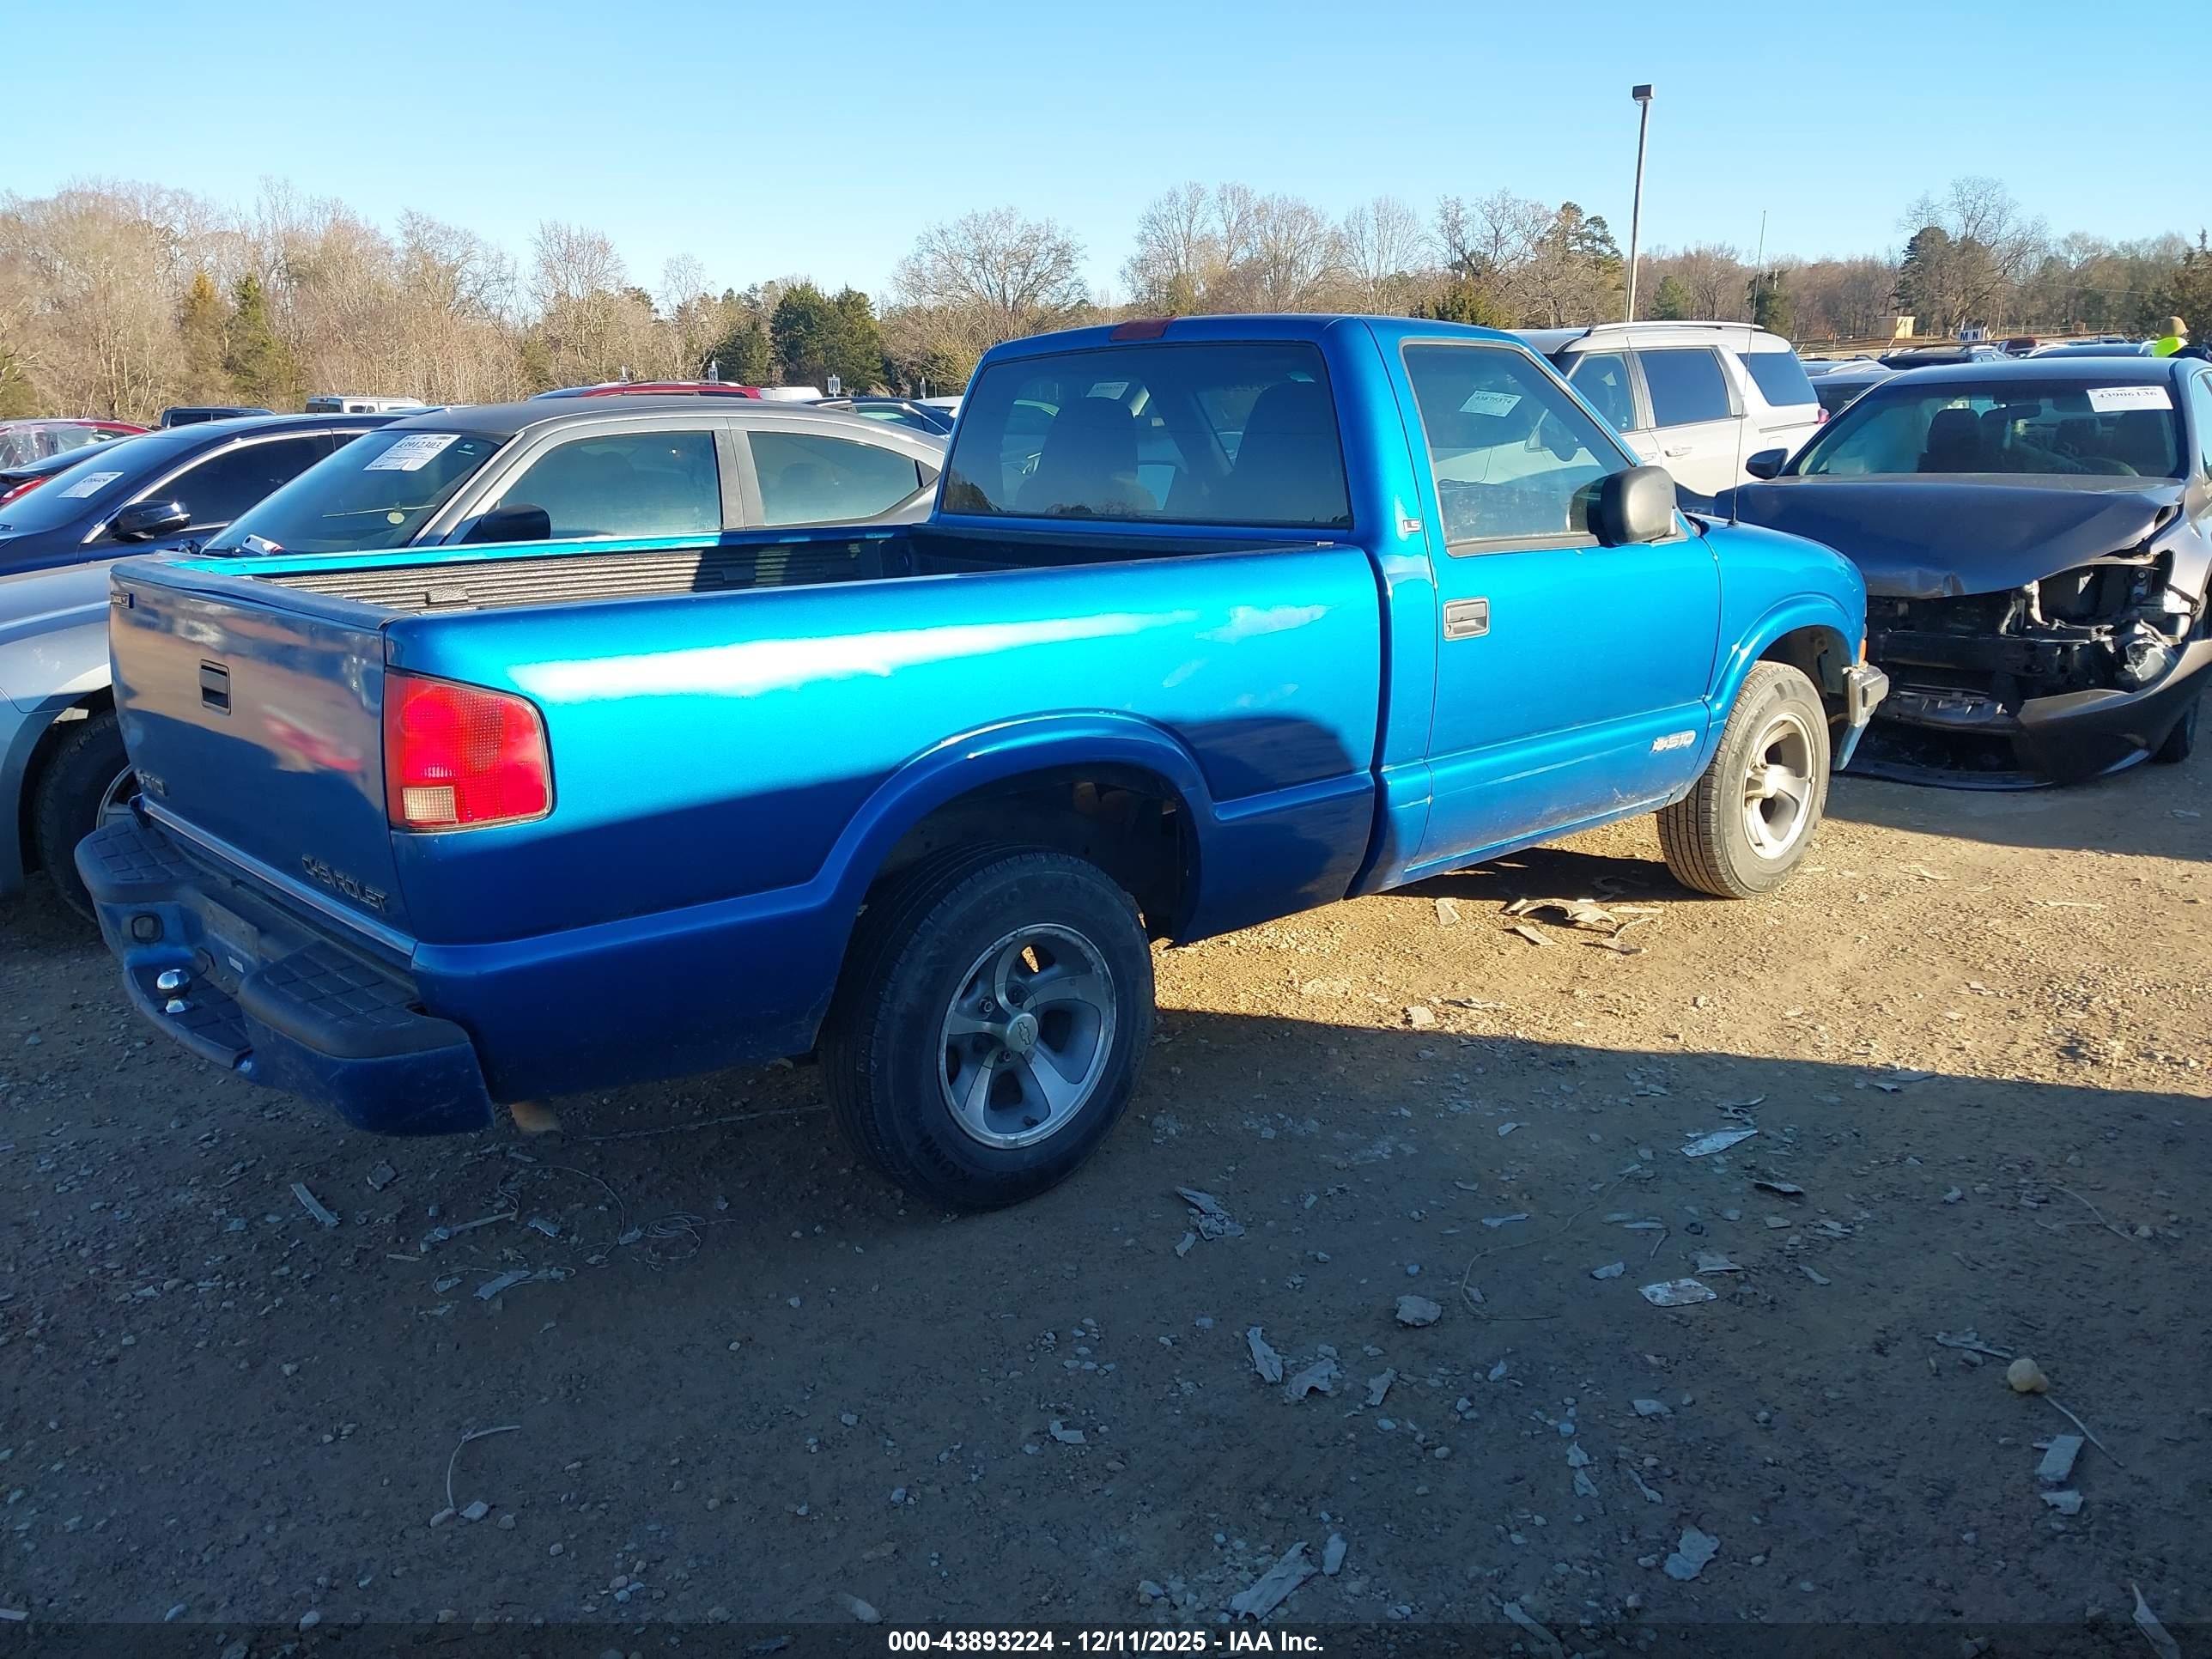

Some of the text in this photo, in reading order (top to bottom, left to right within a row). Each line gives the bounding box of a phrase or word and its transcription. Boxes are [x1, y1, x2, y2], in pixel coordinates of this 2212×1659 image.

[1960, 330, 1978, 341] M N
[1403, 520, 1420, 532] LS
[1666, 730, 1697, 749] S10
[301, 854, 386, 913] CHEVROLET
